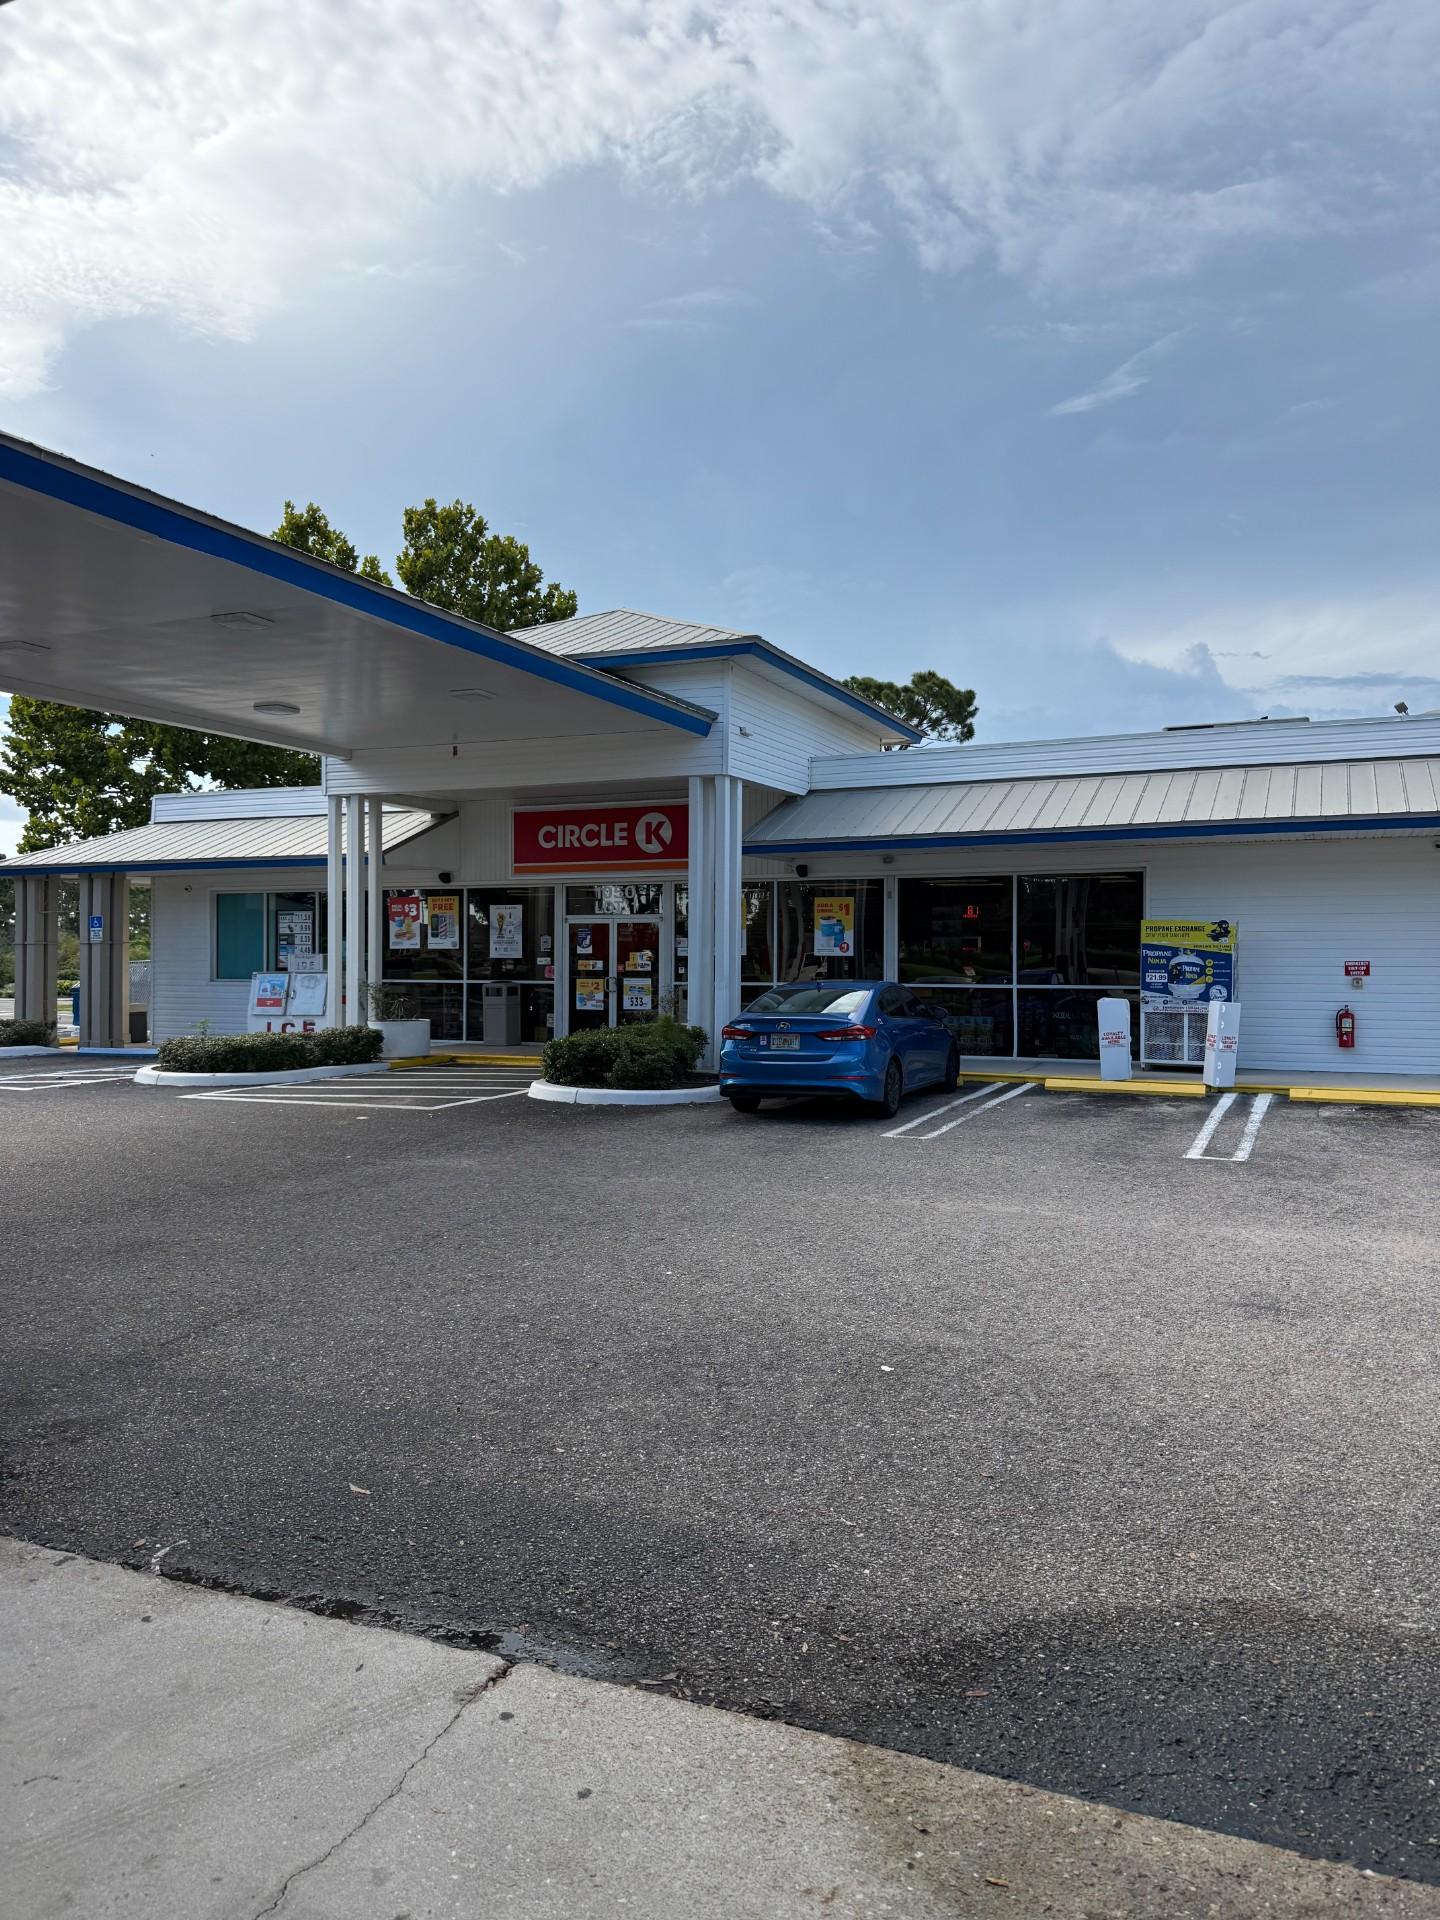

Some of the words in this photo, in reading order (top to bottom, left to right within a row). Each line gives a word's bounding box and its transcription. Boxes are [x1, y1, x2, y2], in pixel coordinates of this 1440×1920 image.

[538, 823, 628, 848] CIRCLE
[640, 815, 672, 852] K
[594, 885, 636, 899] 1050
[404, 903, 417, 916] $3
[432, 903, 454, 911] FREE
[1143, 949, 1172, 957] PROPANE
[1147, 957, 1167, 965] NINJA
[1147, 973, 1167, 981] $21.99
[267, 1020, 316, 1033] ICE
